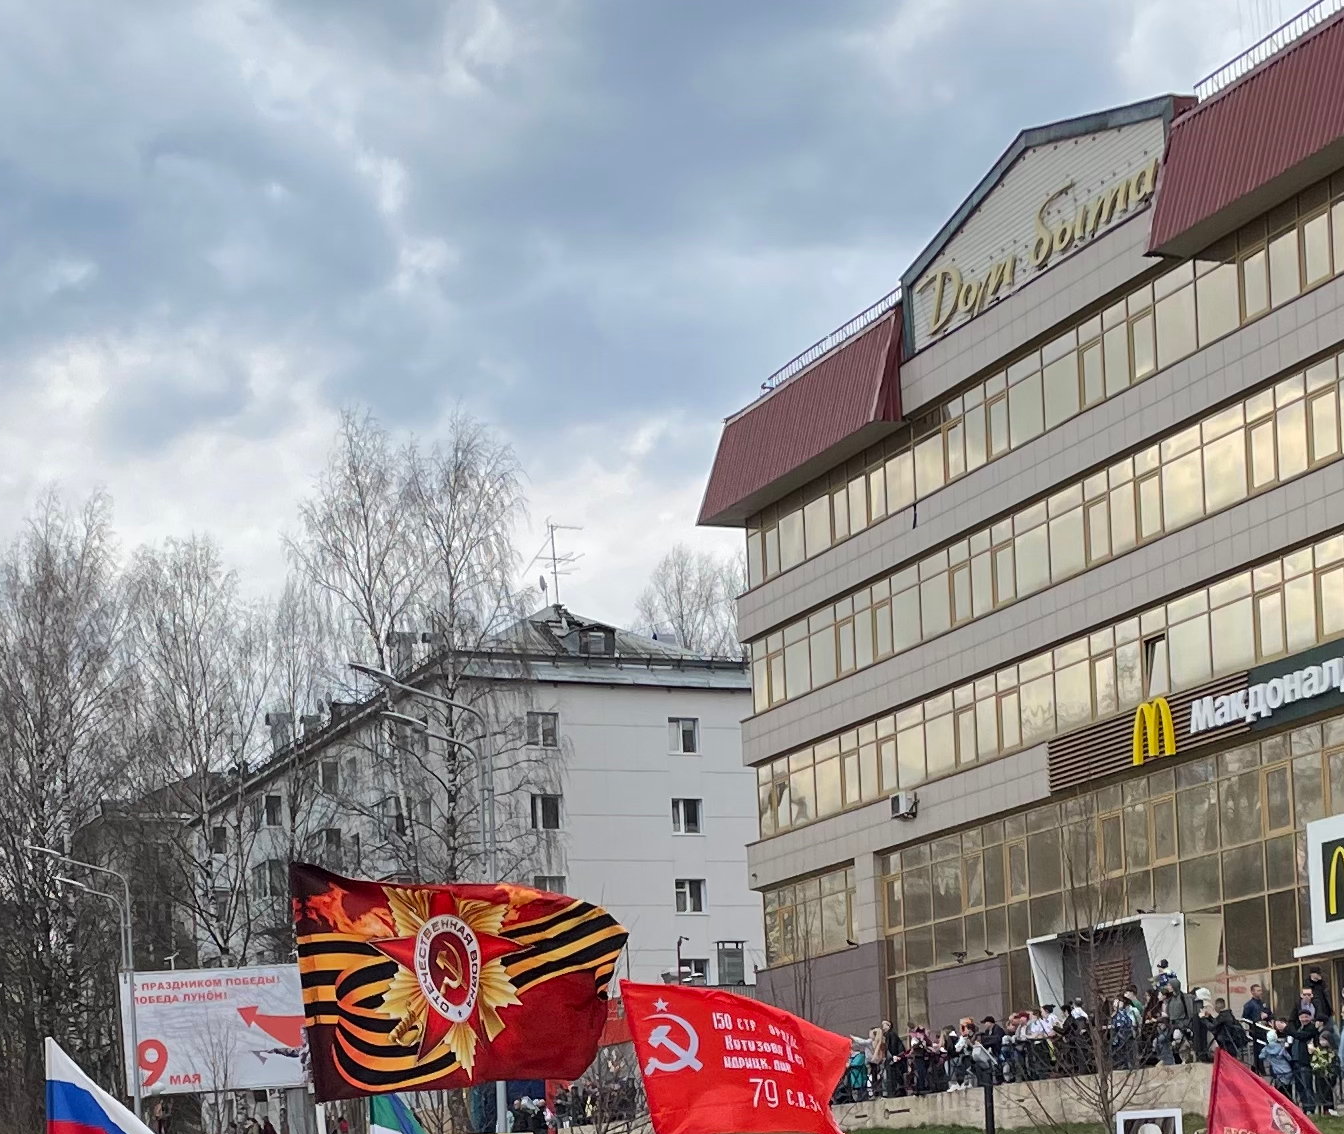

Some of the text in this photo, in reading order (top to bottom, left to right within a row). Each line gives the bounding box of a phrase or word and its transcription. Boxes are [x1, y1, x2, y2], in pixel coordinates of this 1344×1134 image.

[917, 157, 1159, 335] Дом быта
[418, 919, 478, 1013] ОТЕЧЕСТВЕННАЯ ВОЙНА
[141, 978, 222, 991] ПРАЗДНИКОМ
[225, 975, 281, 986] ПОБЕДЫ!
[134, 995, 179, 1005] ПОБЕДА
[711, 1011, 734, 1030] 150
[137, 1039, 202, 1087] 9 МАЯ
[749, 1078, 780, 1108] 79
